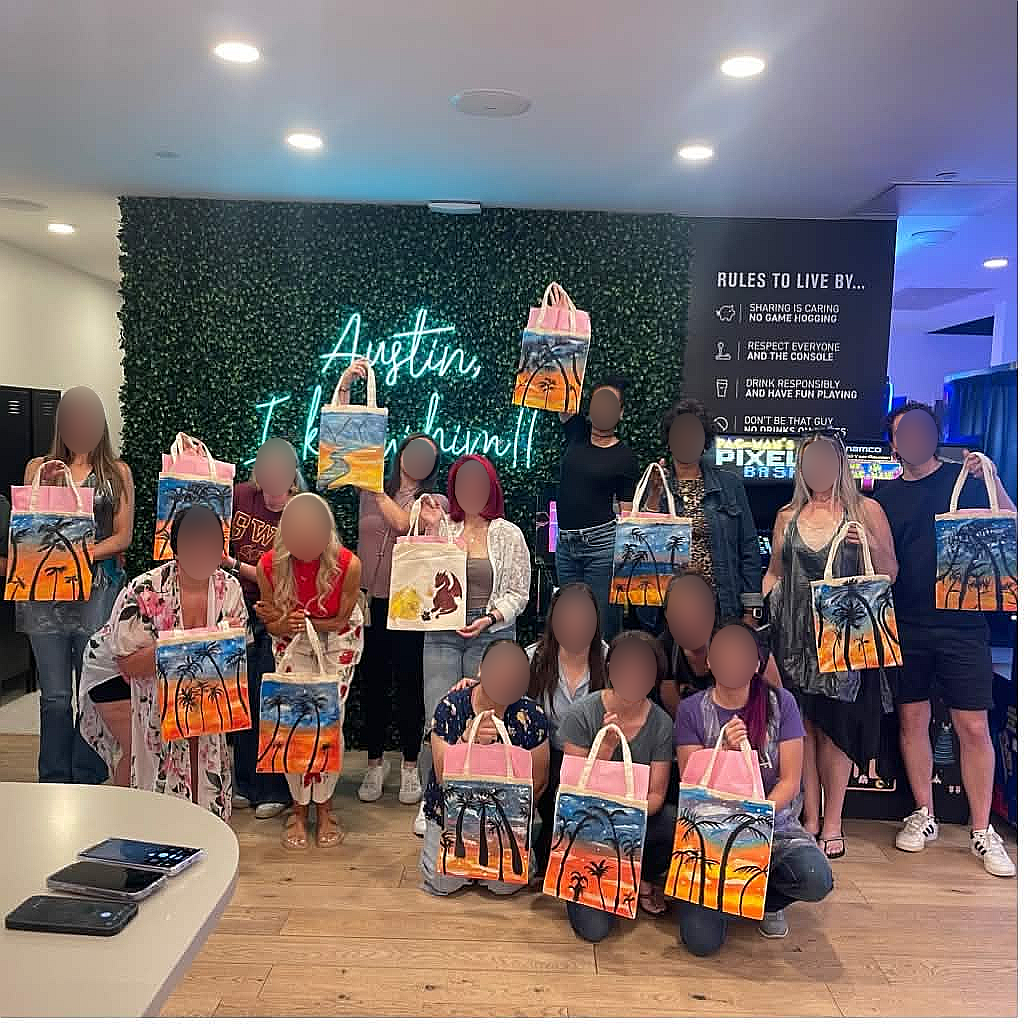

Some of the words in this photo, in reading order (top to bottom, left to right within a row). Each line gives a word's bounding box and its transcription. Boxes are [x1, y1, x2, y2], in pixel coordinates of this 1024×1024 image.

[717, 271, 766, 288] RULES
[772, 273, 790, 289] TO
[797, 273, 829, 289] LIVE
[835, 274, 865, 290] BY...
[749, 303, 791, 313] SHARING
[793, 304, 803, 314] IS
[804, 304, 840, 314] CARING
[749, 314, 763, 323] NO
[765, 314, 792, 323] GAME
[794, 314, 838, 323] HOGGING
[320, 309, 481, 386] Austin,
[747, 341, 789, 351] RESPECT
[791, 342, 840, 352] EVERYONE
[747, 352, 767, 361] AND
[769, 352, 788, 361] THE
[790, 352, 834, 361] CONSOLE
[745, 379, 775, 388] DRINK
[777, 379, 841, 389] RESPONSIBLY
[745, 389, 766, 398] AND
[767, 389, 793, 398] HAVE
[795, 390, 815, 399] FUN
[817, 390, 858, 400] PLAYING
[744, 415, 771, 425] DON'T
[773, 416, 786, 426] BE
[787, 417, 811, 426] THAT
[813, 417, 834, 427] GUY
